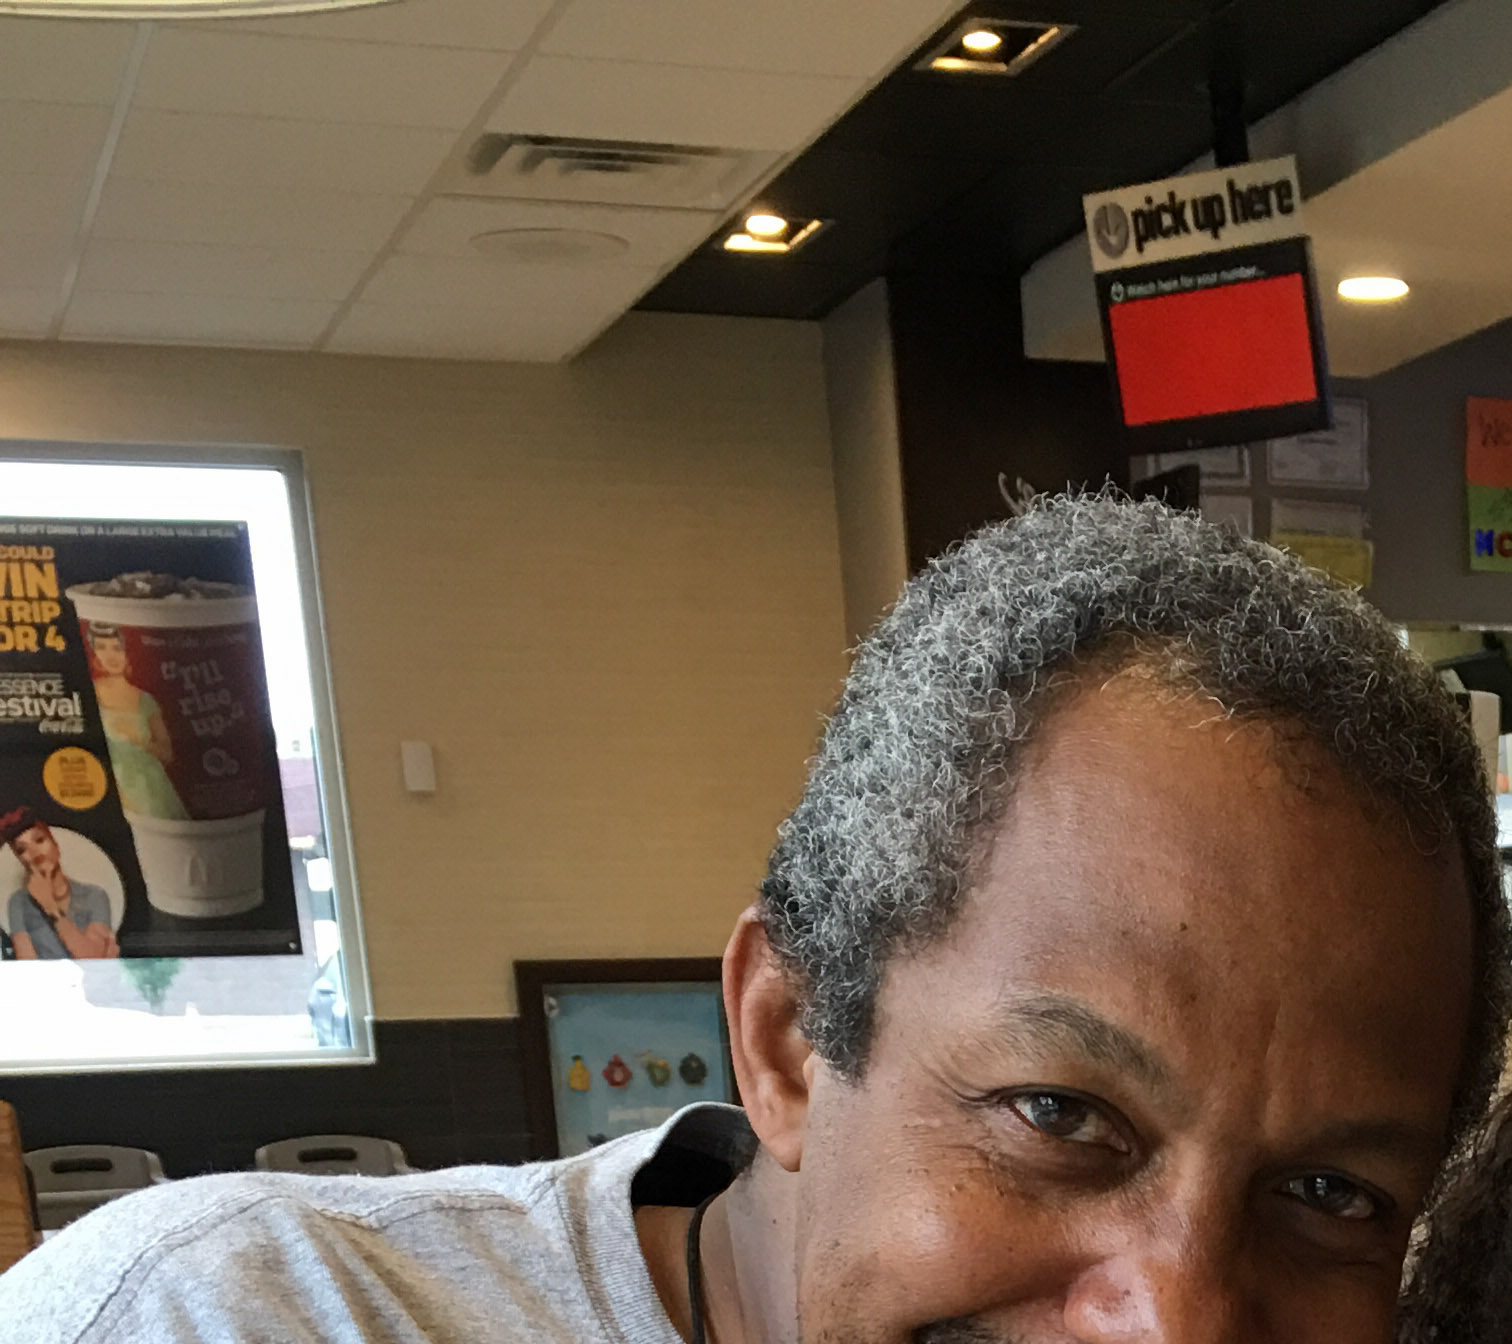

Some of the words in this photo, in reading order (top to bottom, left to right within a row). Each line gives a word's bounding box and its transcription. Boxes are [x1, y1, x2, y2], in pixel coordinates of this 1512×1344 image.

[1131, 191, 1191, 254] pick
[1192, 194, 1226, 239] up
[1226, 178, 1294, 226] here
[0, 561, 60, 599] IN
[0, 625, 40, 652] OR
[44, 626, 66, 651] 4
[0, 679, 64, 696] SSENCE
[0, 691, 82, 717] estival
